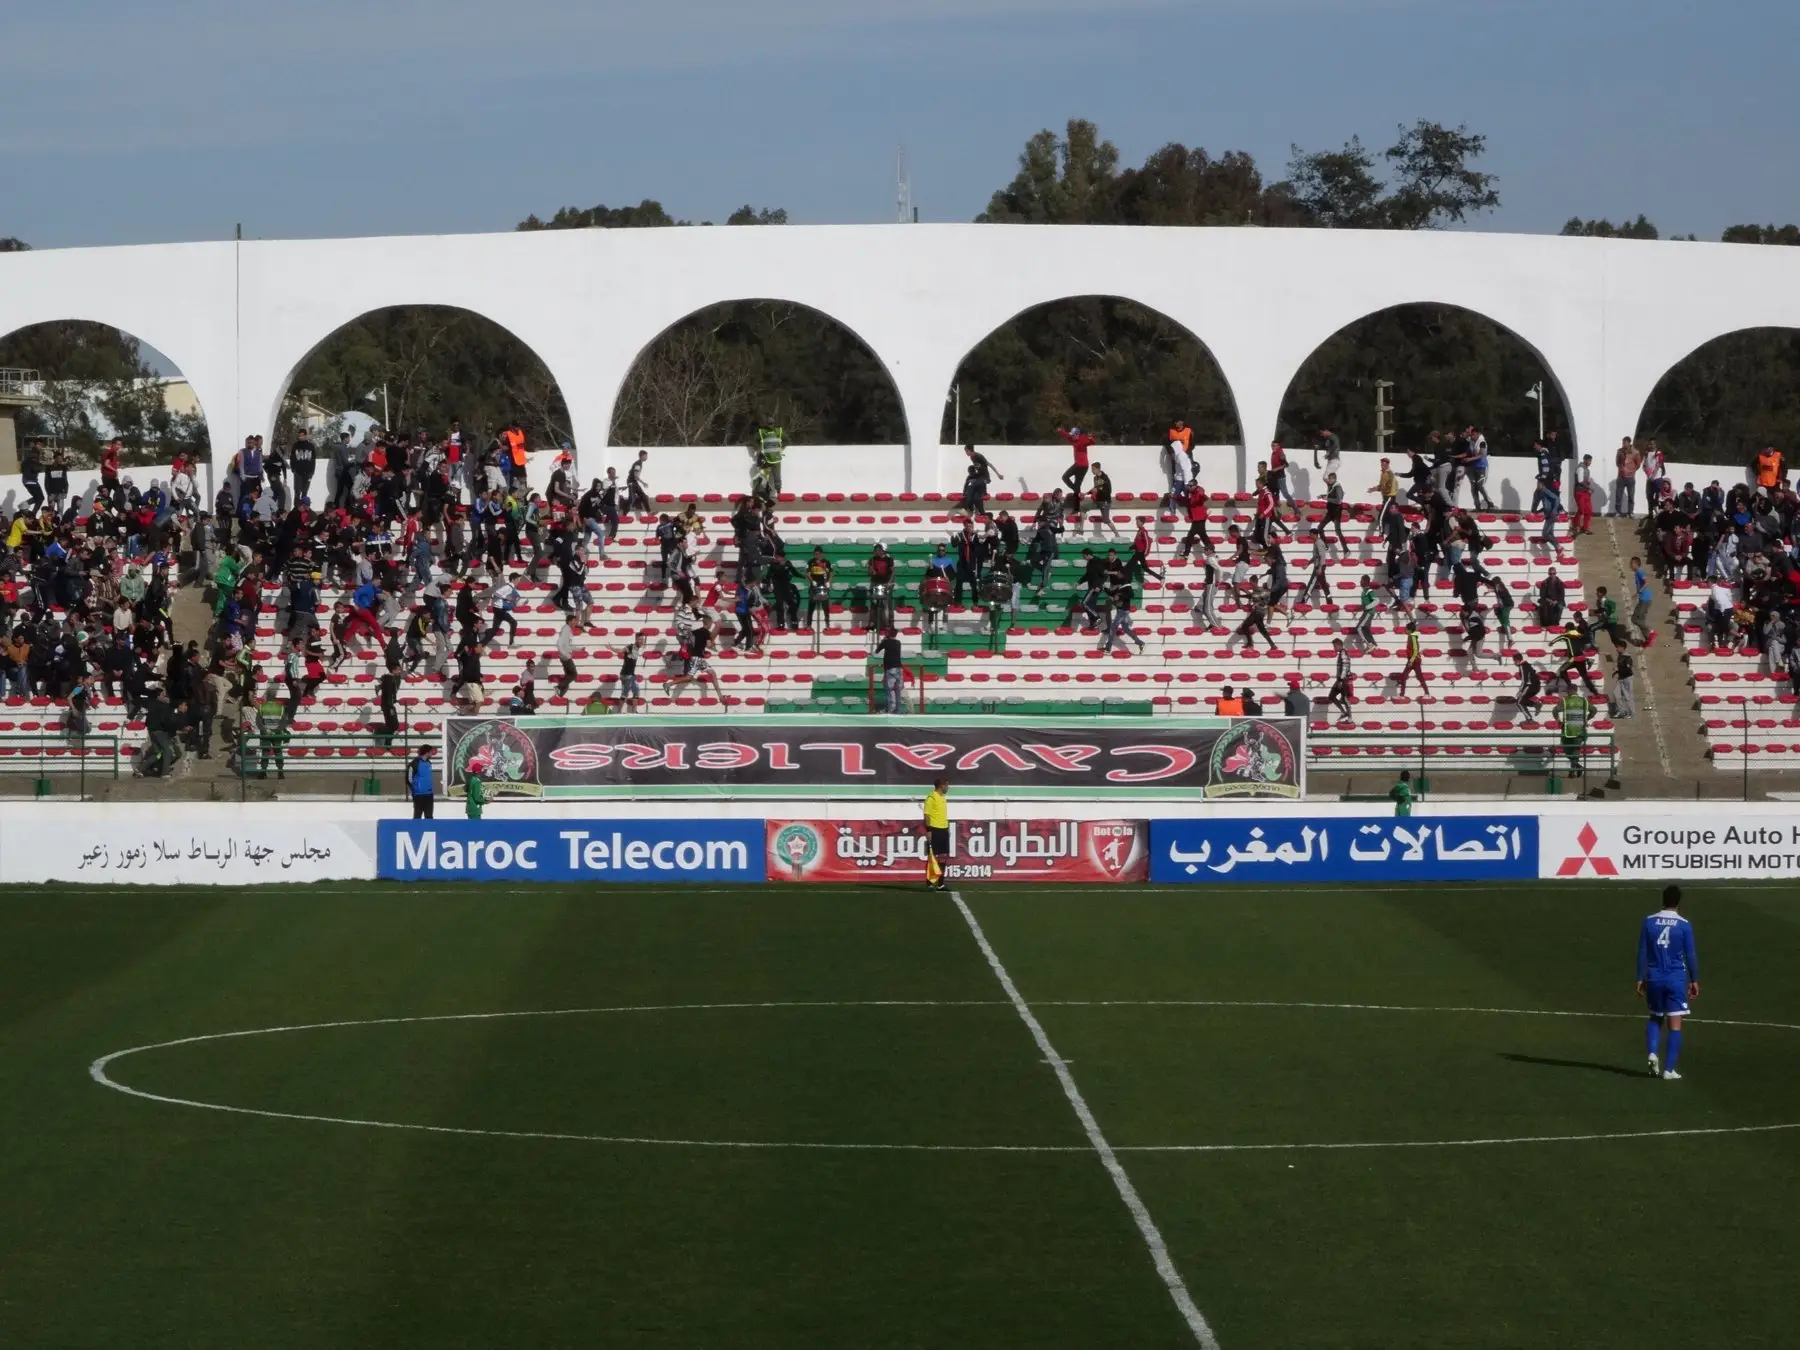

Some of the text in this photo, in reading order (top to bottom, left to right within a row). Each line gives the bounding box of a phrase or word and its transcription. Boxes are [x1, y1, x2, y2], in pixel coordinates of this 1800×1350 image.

[77, 837, 331, 870] مجلس جهة الرباط سلا زمور زعير
[395, 831, 538, 870] Maroc
[559, 831, 748, 870] Telecom
[968, 821, 1079, 867] البطولة
[1169, 824, 1521, 875] اتصالات المغرب
[1623, 825, 1717, 850] Groupe
[1723, 825, 1783, 845] Auto
[1622, 853, 1800, 869] MITSUBISHI MOT
[1657, 925, 1671, 949] 4
